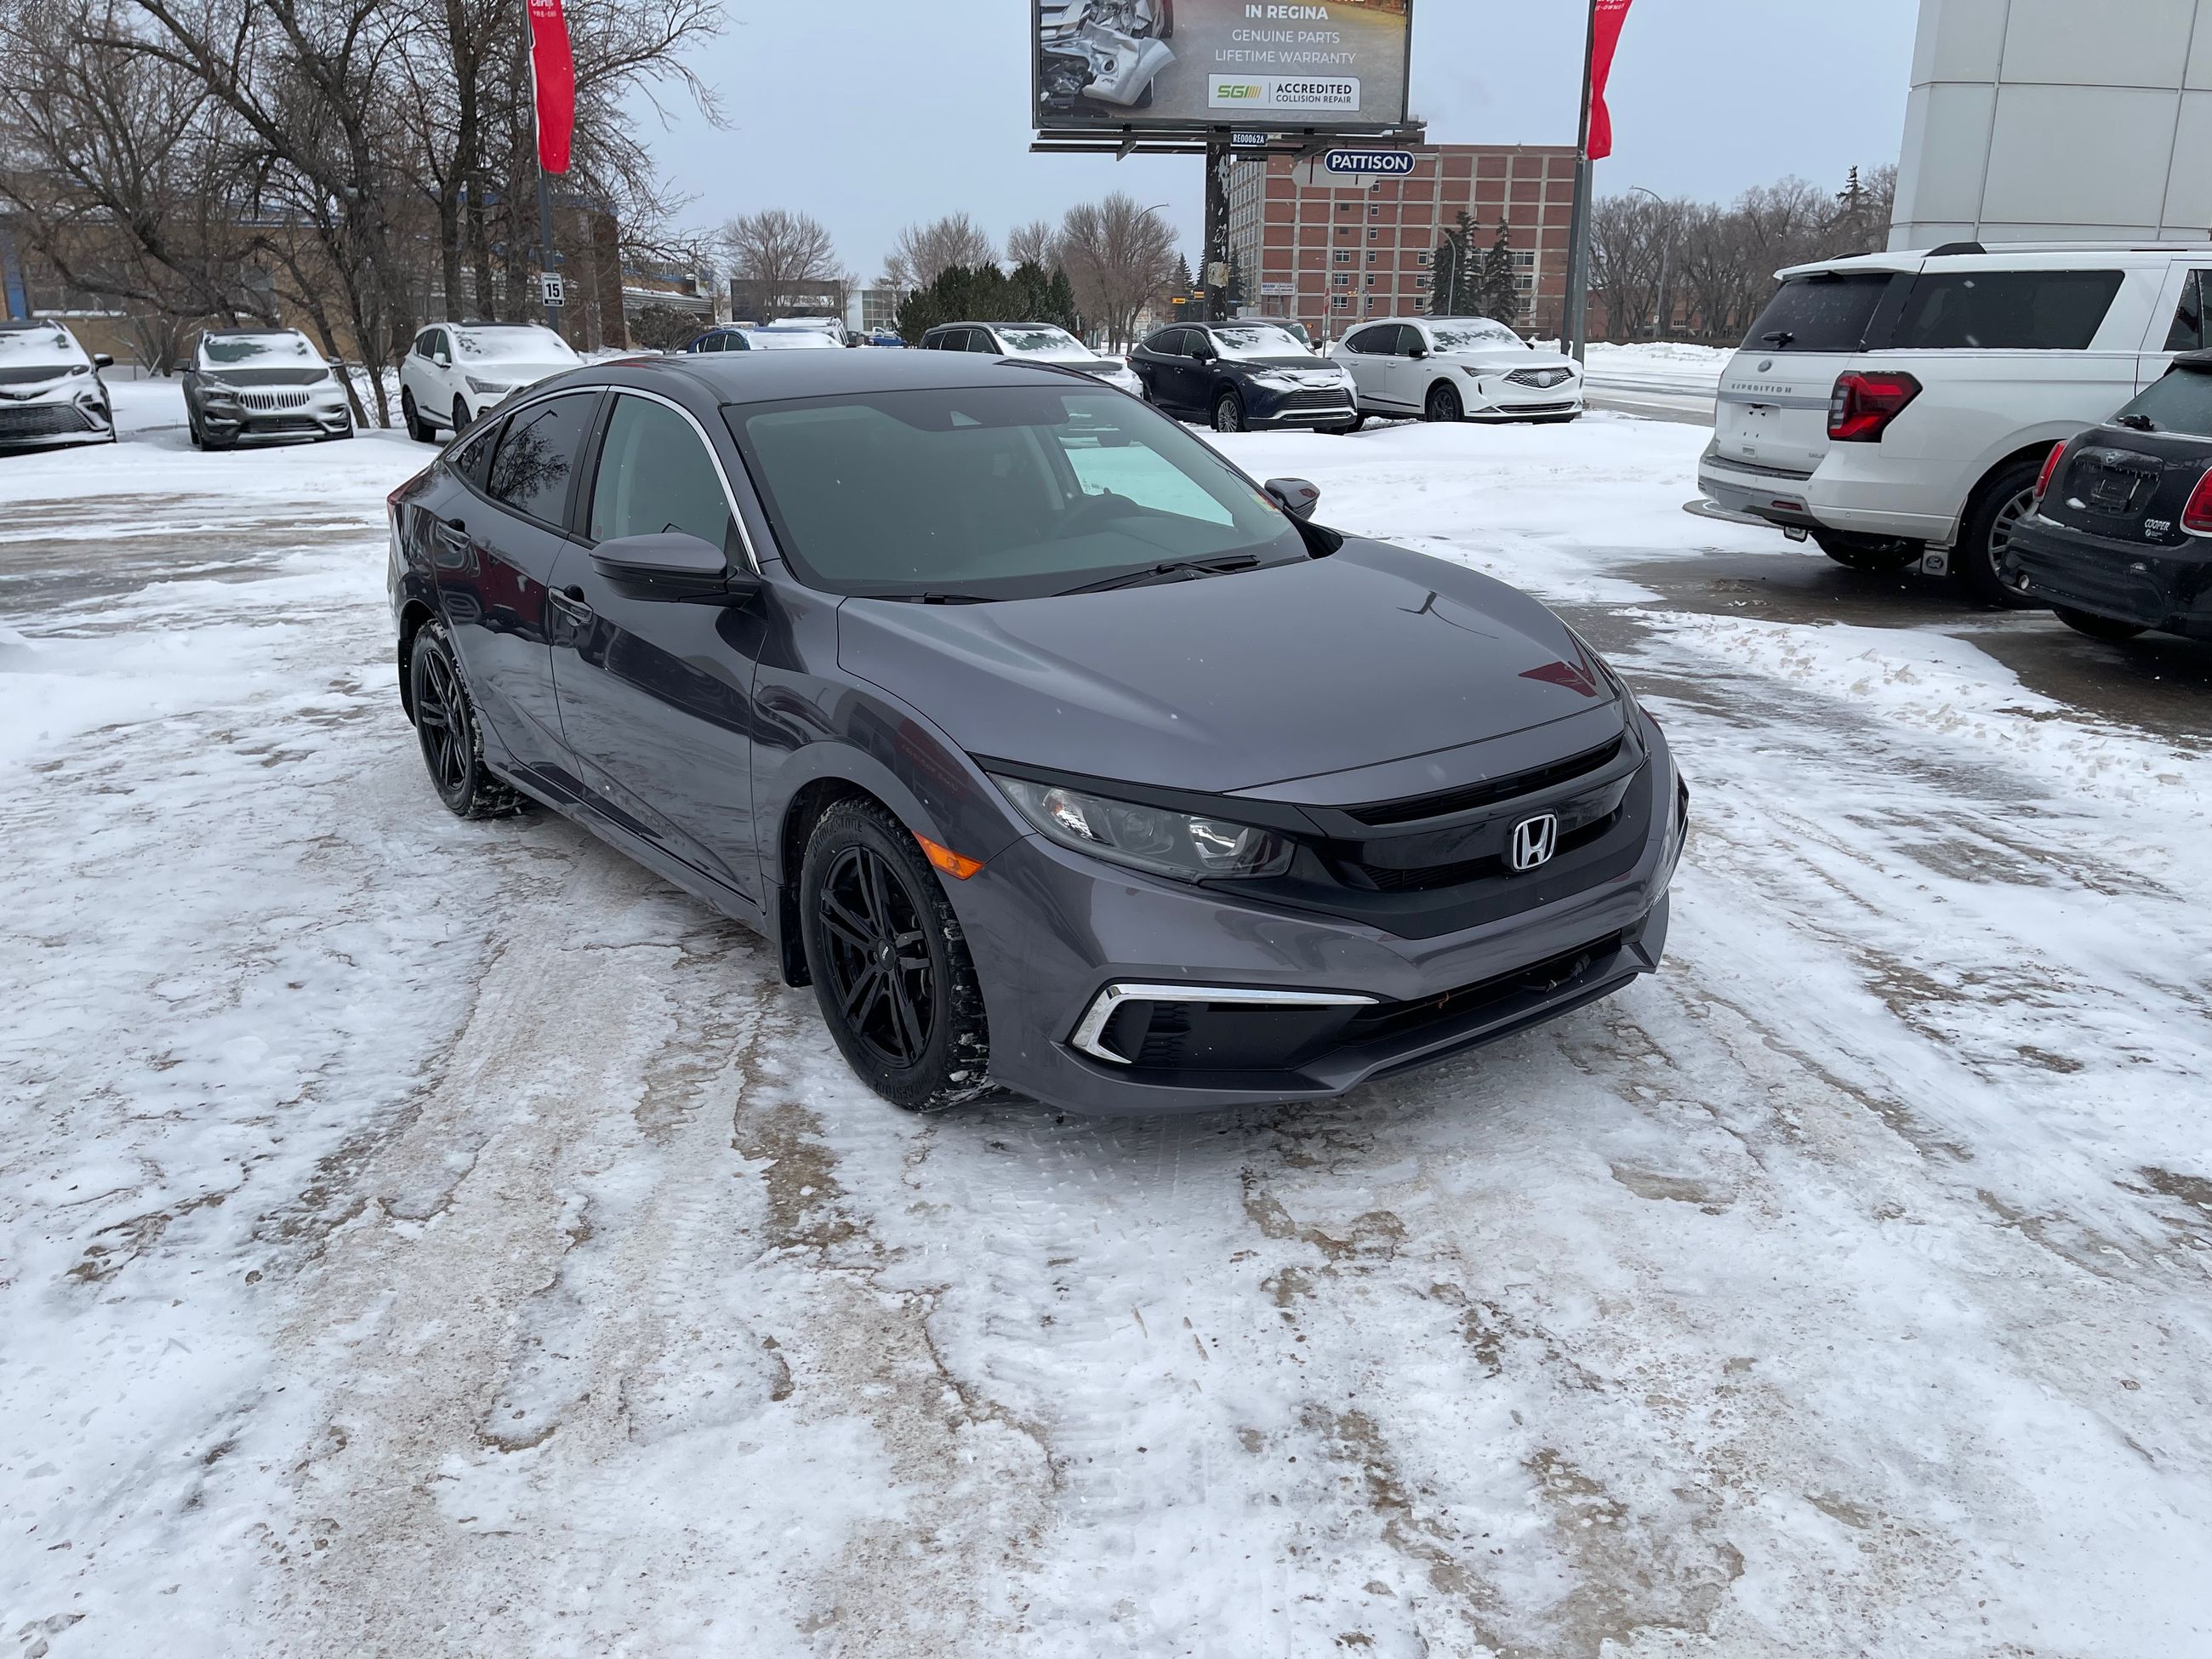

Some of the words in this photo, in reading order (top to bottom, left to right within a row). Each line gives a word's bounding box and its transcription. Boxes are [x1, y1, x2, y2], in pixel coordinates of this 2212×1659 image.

[1245, 4, 1262, 18] IN
[1267, 5, 1328, 20] REGINA
[1232, 29, 1294, 43] GENUINE
[1297, 31, 1340, 43] PARTS
[1215, 49, 1275, 62] LIFETIME
[1279, 51, 1356, 64] WARRANTY
[1276, 83, 1352, 94] ACCREDITED
[1331, 155, 1408, 170] PATTISON
[545, 283, 560, 297] 15
[1731, 384, 1792, 393] EXPEDITION
[2145, 519, 2170, 531] COOPER
